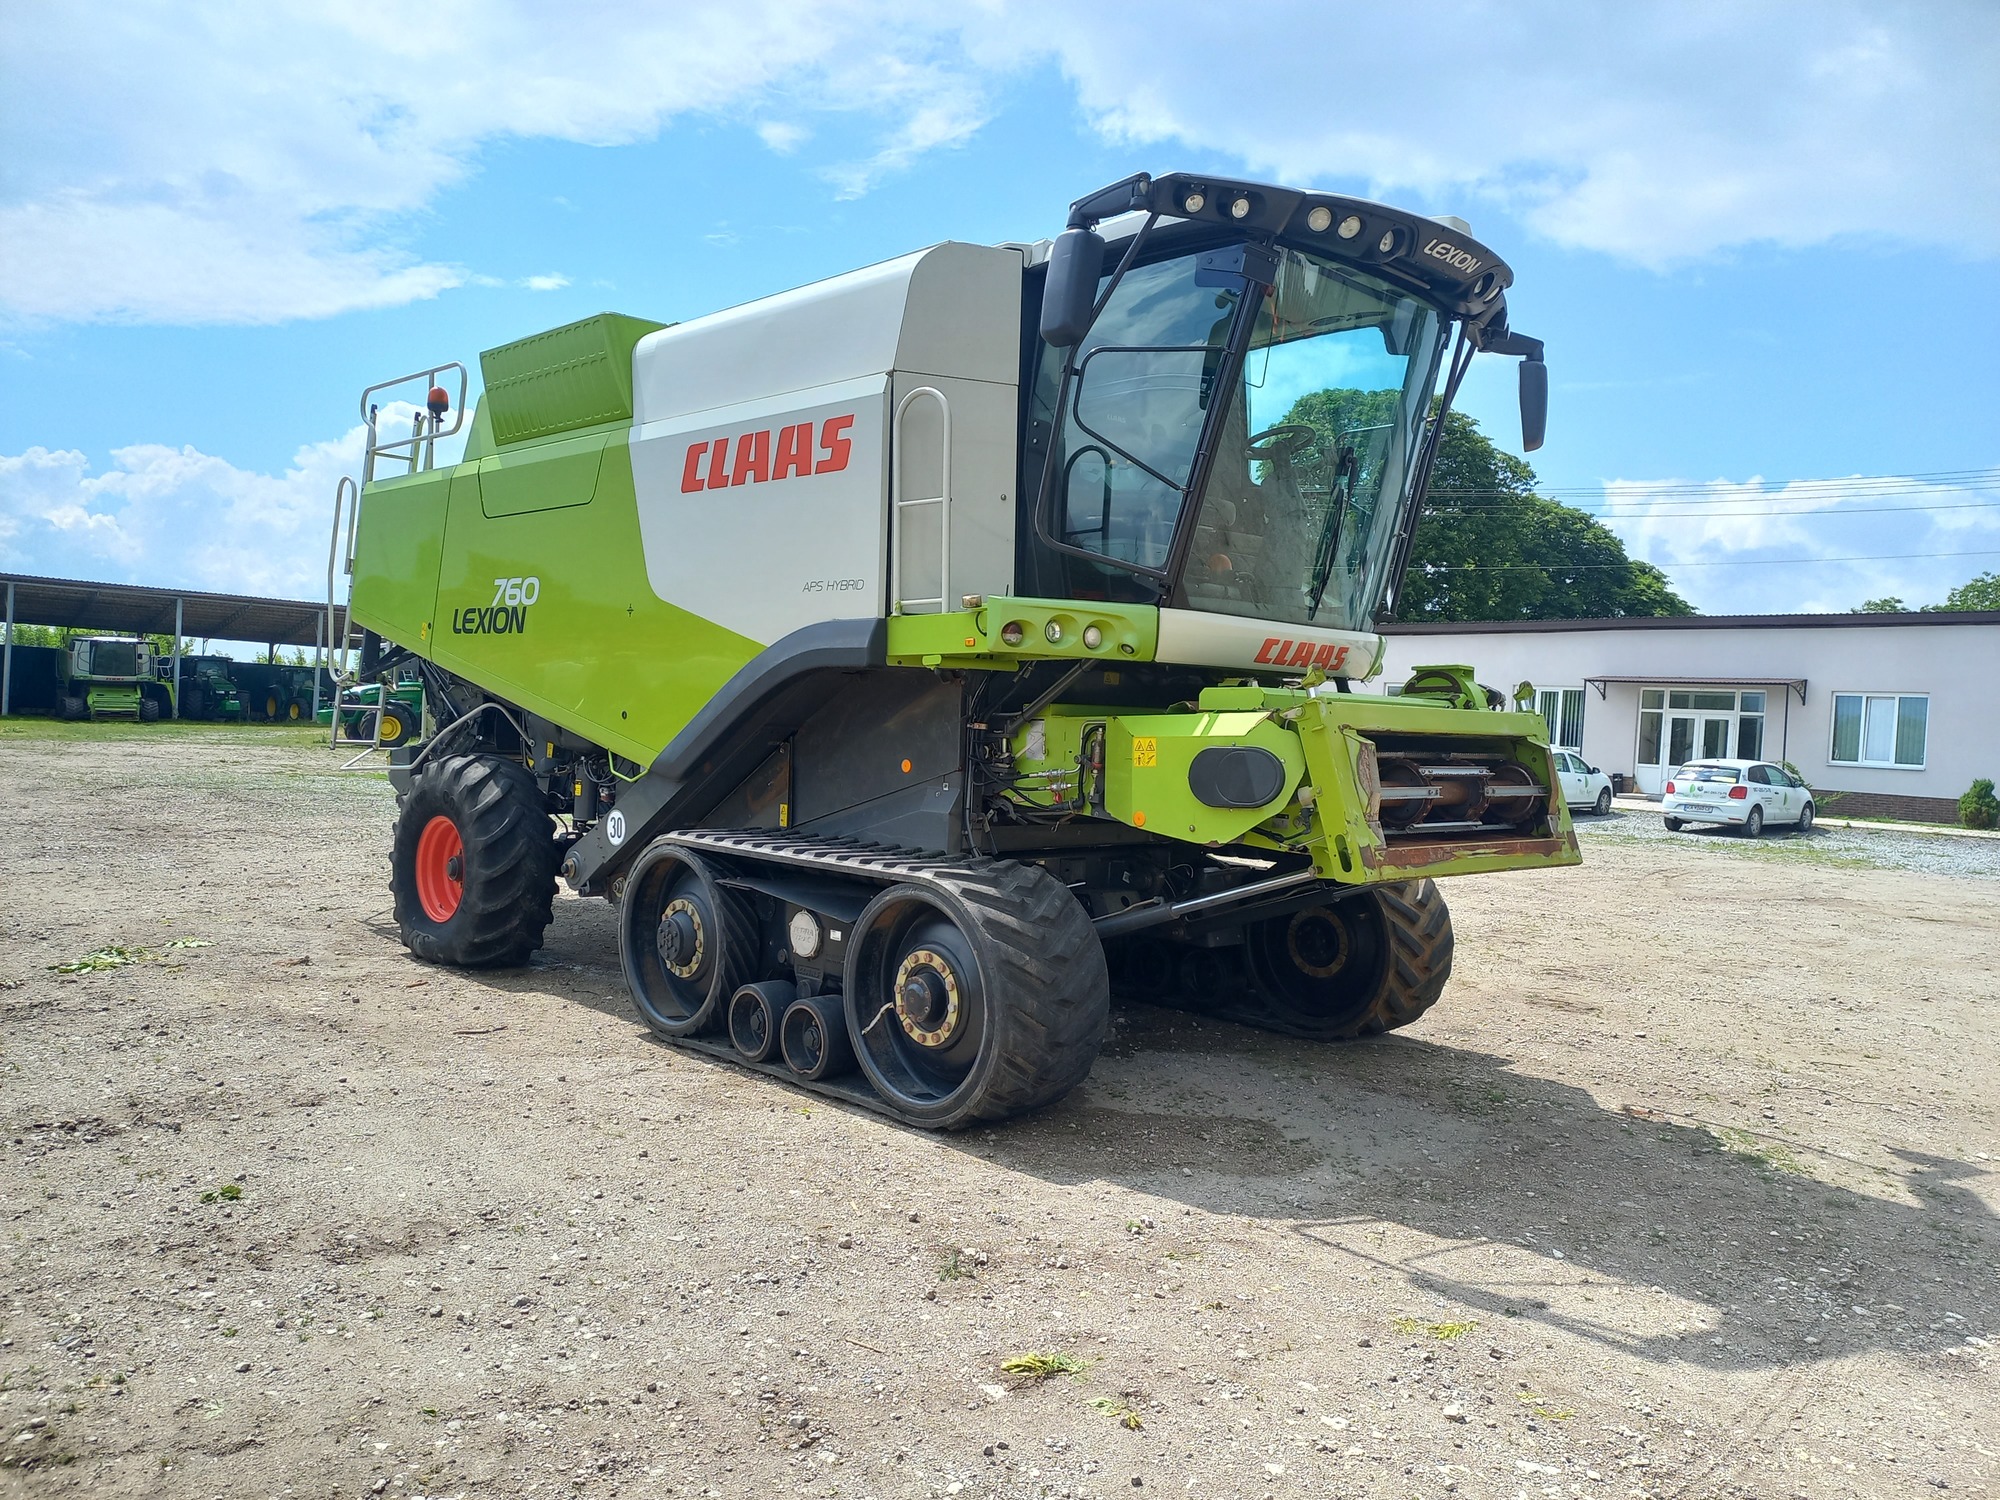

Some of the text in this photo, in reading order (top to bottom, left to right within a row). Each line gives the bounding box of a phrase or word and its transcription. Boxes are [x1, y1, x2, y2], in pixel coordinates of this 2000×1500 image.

[1423, 238, 1482, 274] LEXION
[680, 413, 855, 494] CLAAS
[491, 576, 540, 607] 760
[801, 579, 865, 593] APS HYBRID
[452, 606, 527, 635] LEXION
[1253, 637, 1350, 672] CLAAS
[609, 816, 623, 839] 30
[793, 926, 814, 937] TERRA
